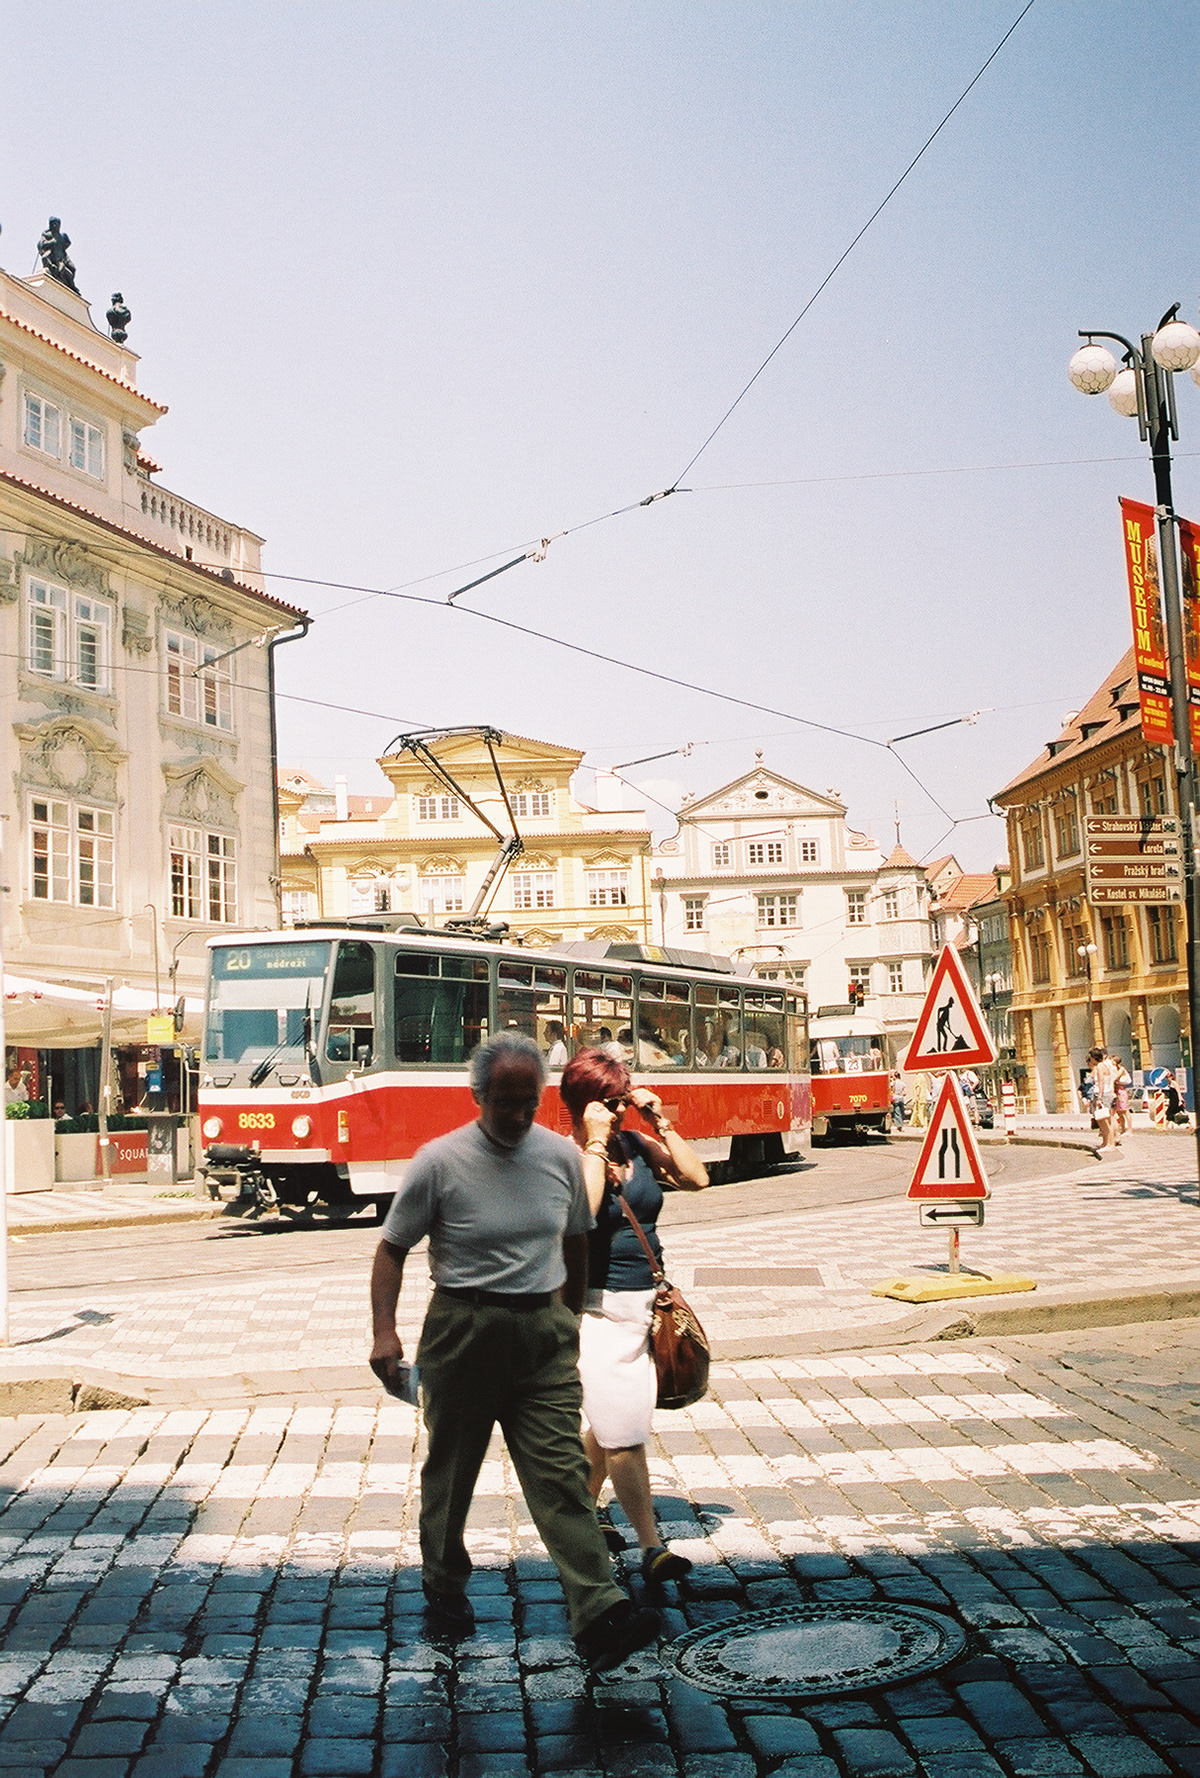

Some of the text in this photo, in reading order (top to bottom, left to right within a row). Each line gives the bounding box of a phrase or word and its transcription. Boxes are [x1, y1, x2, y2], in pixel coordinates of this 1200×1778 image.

[1126, 519, 1152, 652] MUSEUM
[1102, 821, 1138, 833] Strahovský
[1143, 844, 1163, 854] Loreta
[1123, 865, 1165, 877] Pražský hrad
[1106, 887, 1166, 899] Kostel sv. Mikuláše
[226, 950, 252, 970] 20
[848, 1060, 859, 1071] 23
[849, 1094, 868, 1103] 7070
[238, 1112, 276, 1129] 8633
